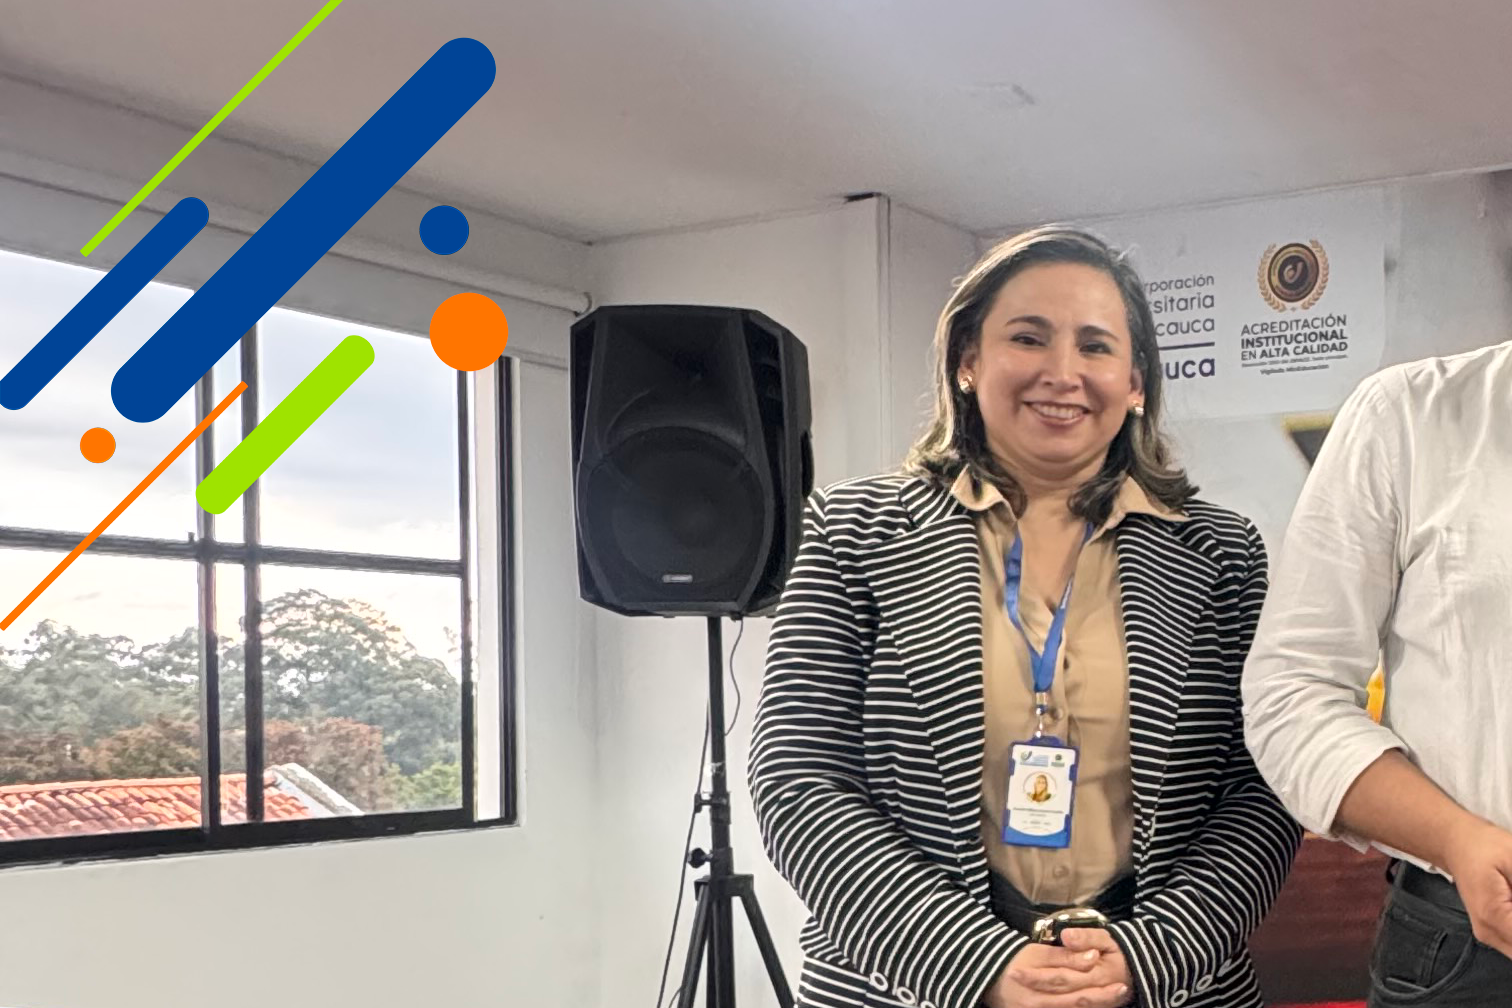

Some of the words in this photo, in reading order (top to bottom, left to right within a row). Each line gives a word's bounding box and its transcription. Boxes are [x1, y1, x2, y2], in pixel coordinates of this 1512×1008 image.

[1150, 292, 1215, 314] sitaria
[1241, 313, 1347, 336] ACREDITACIÓN
[1241, 328, 1348, 349] INSTITUCIONAL
[1241, 350, 1257, 361] EN
[1260, 347, 1290, 359] ALTA
[1292, 341, 1348, 356] CALIDAD
